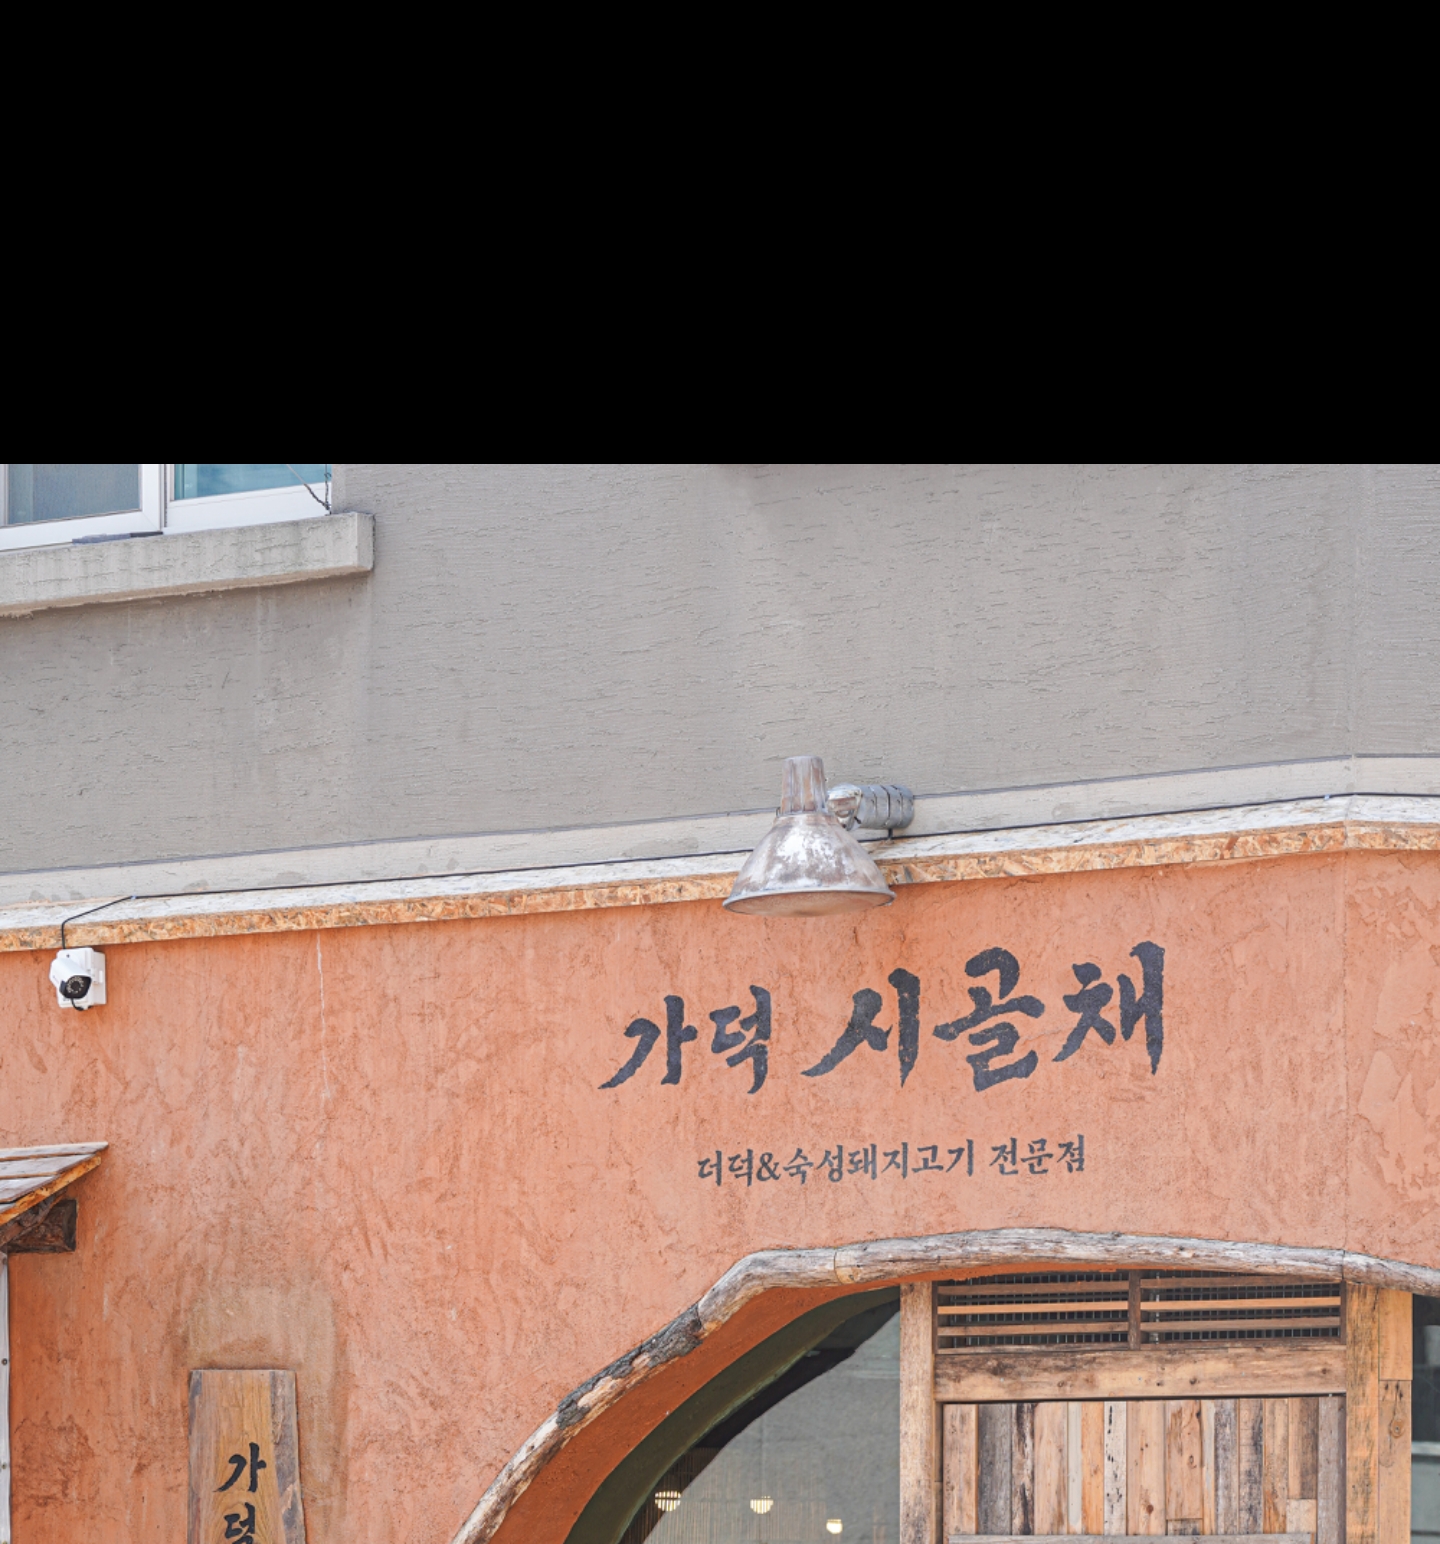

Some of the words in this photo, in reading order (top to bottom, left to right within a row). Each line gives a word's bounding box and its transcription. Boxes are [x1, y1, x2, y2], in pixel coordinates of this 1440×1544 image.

[598, 984, 772, 1094] 가덕
[801, 940, 1166, 1092] 시골채
[697, 1138, 974, 1187] 더덕&숙성돼지고기
[989, 1134, 1085, 1175] 전문점
